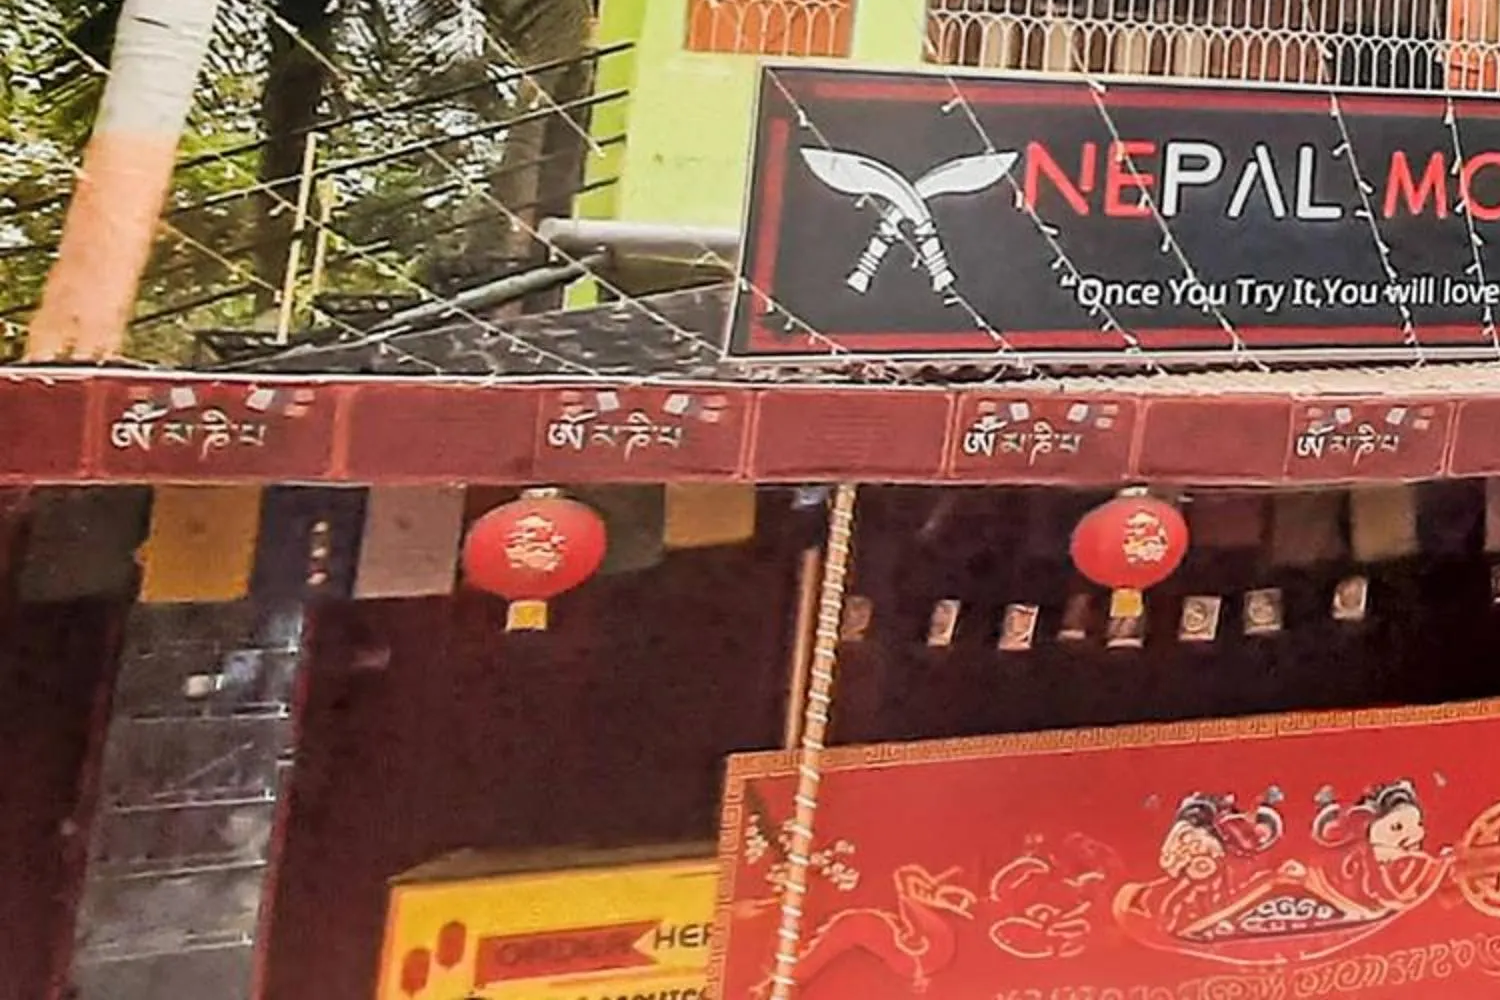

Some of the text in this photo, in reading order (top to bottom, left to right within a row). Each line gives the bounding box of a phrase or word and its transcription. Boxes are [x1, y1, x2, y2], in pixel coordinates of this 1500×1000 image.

[1023, 139, 1342, 222] NEPAL
[1170, 278, 1227, 306] You
[1236, 278, 1285, 313] Try
[1384, 277, 1434, 305] will
[1444, 276, 1500, 305] love
